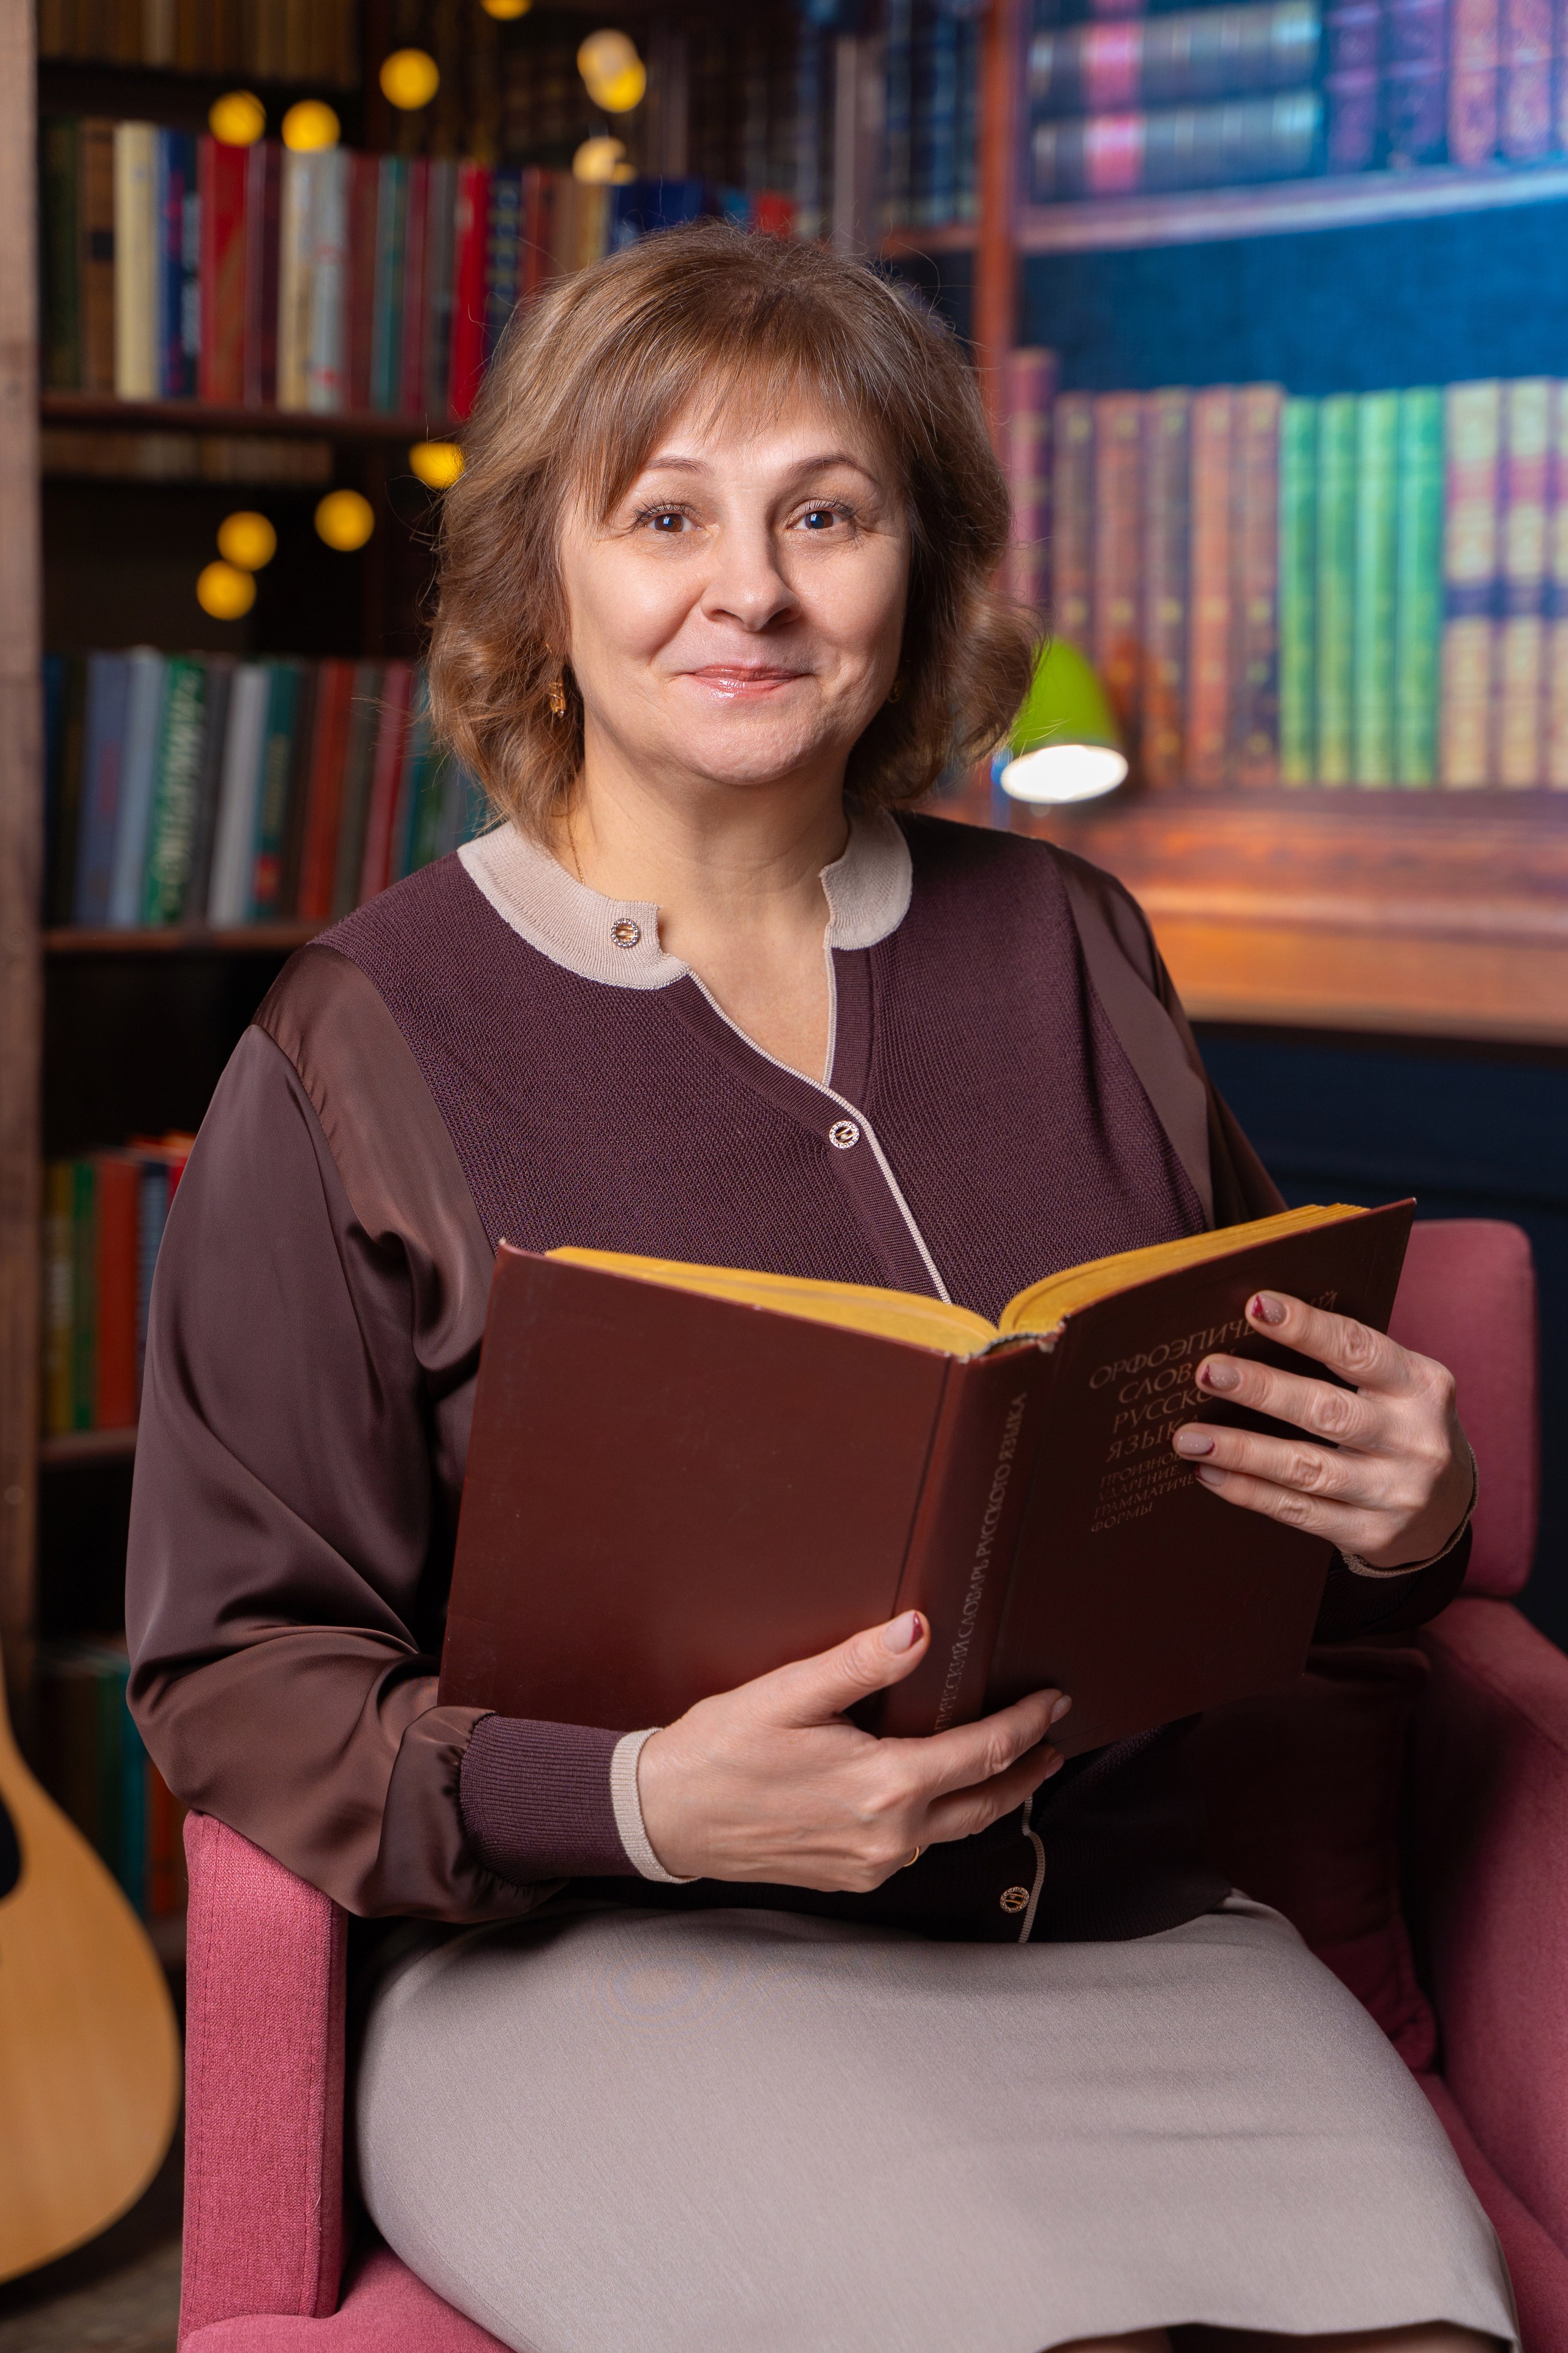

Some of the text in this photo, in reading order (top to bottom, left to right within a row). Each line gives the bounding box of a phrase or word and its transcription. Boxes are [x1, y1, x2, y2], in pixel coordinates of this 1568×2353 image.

[1089, 1290, 1338, 1389] ОРФОЭПИЧЕЙ
[1091, 1501, 1153, 1533] ФОРМЫ
[1094, 1474, 1196, 1519] ГРАММАТИЧЕ
[933, 1391, 1028, 1734] ПИЧЕСКИЙ СЛОВАРЬ РУССКОГО ЯЗЫКА
